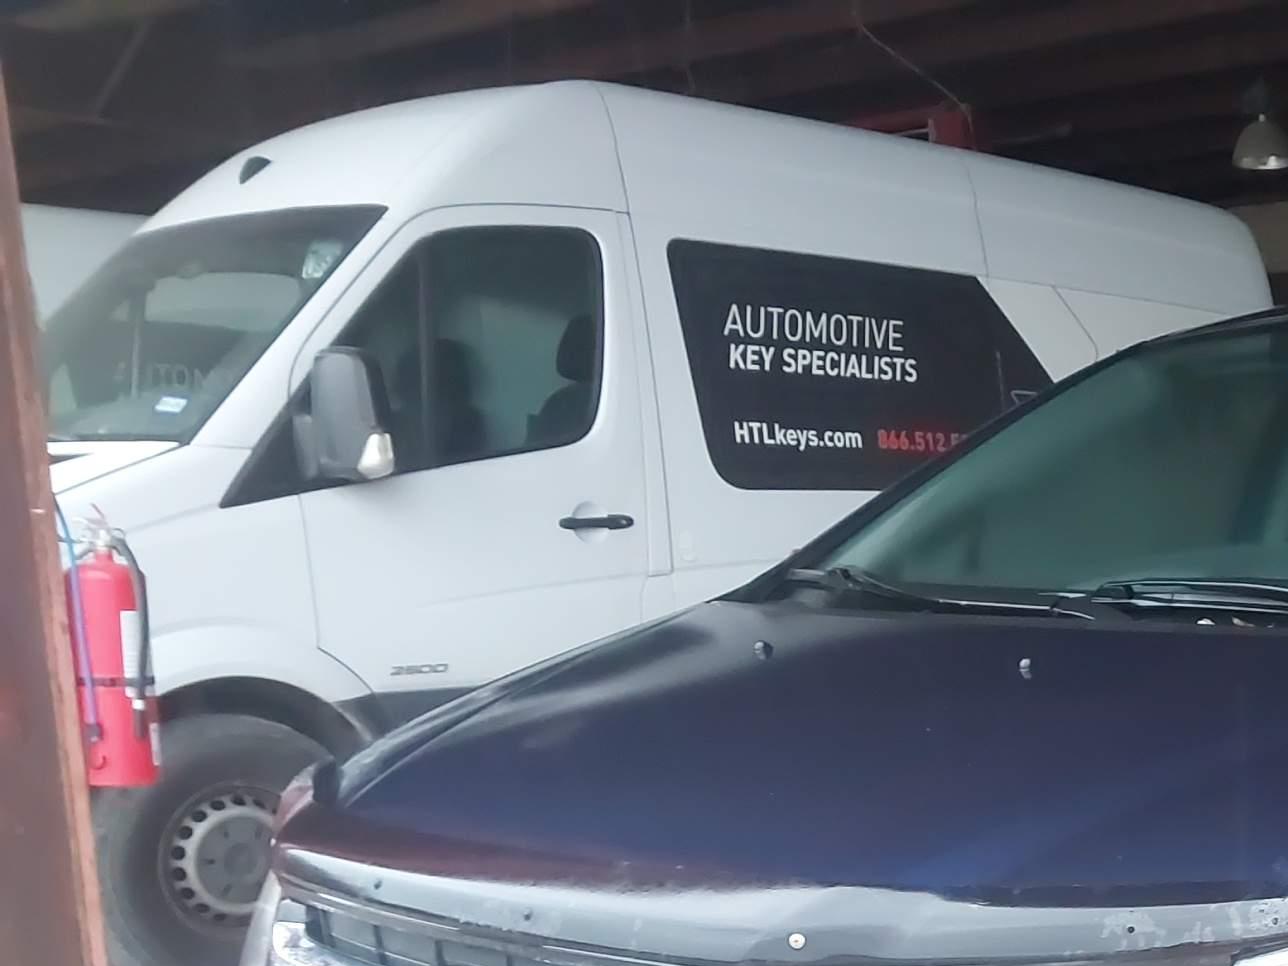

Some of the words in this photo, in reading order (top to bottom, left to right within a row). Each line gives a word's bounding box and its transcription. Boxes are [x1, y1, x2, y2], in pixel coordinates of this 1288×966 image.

[723, 303, 904, 352] AUTOMOTIVE
[729, 343, 775, 372] KEY
[782, 347, 918, 384] SPECIALISTS
[733, 420, 863, 452] HTLkeys.com
[389, 663, 449, 676] 2500
